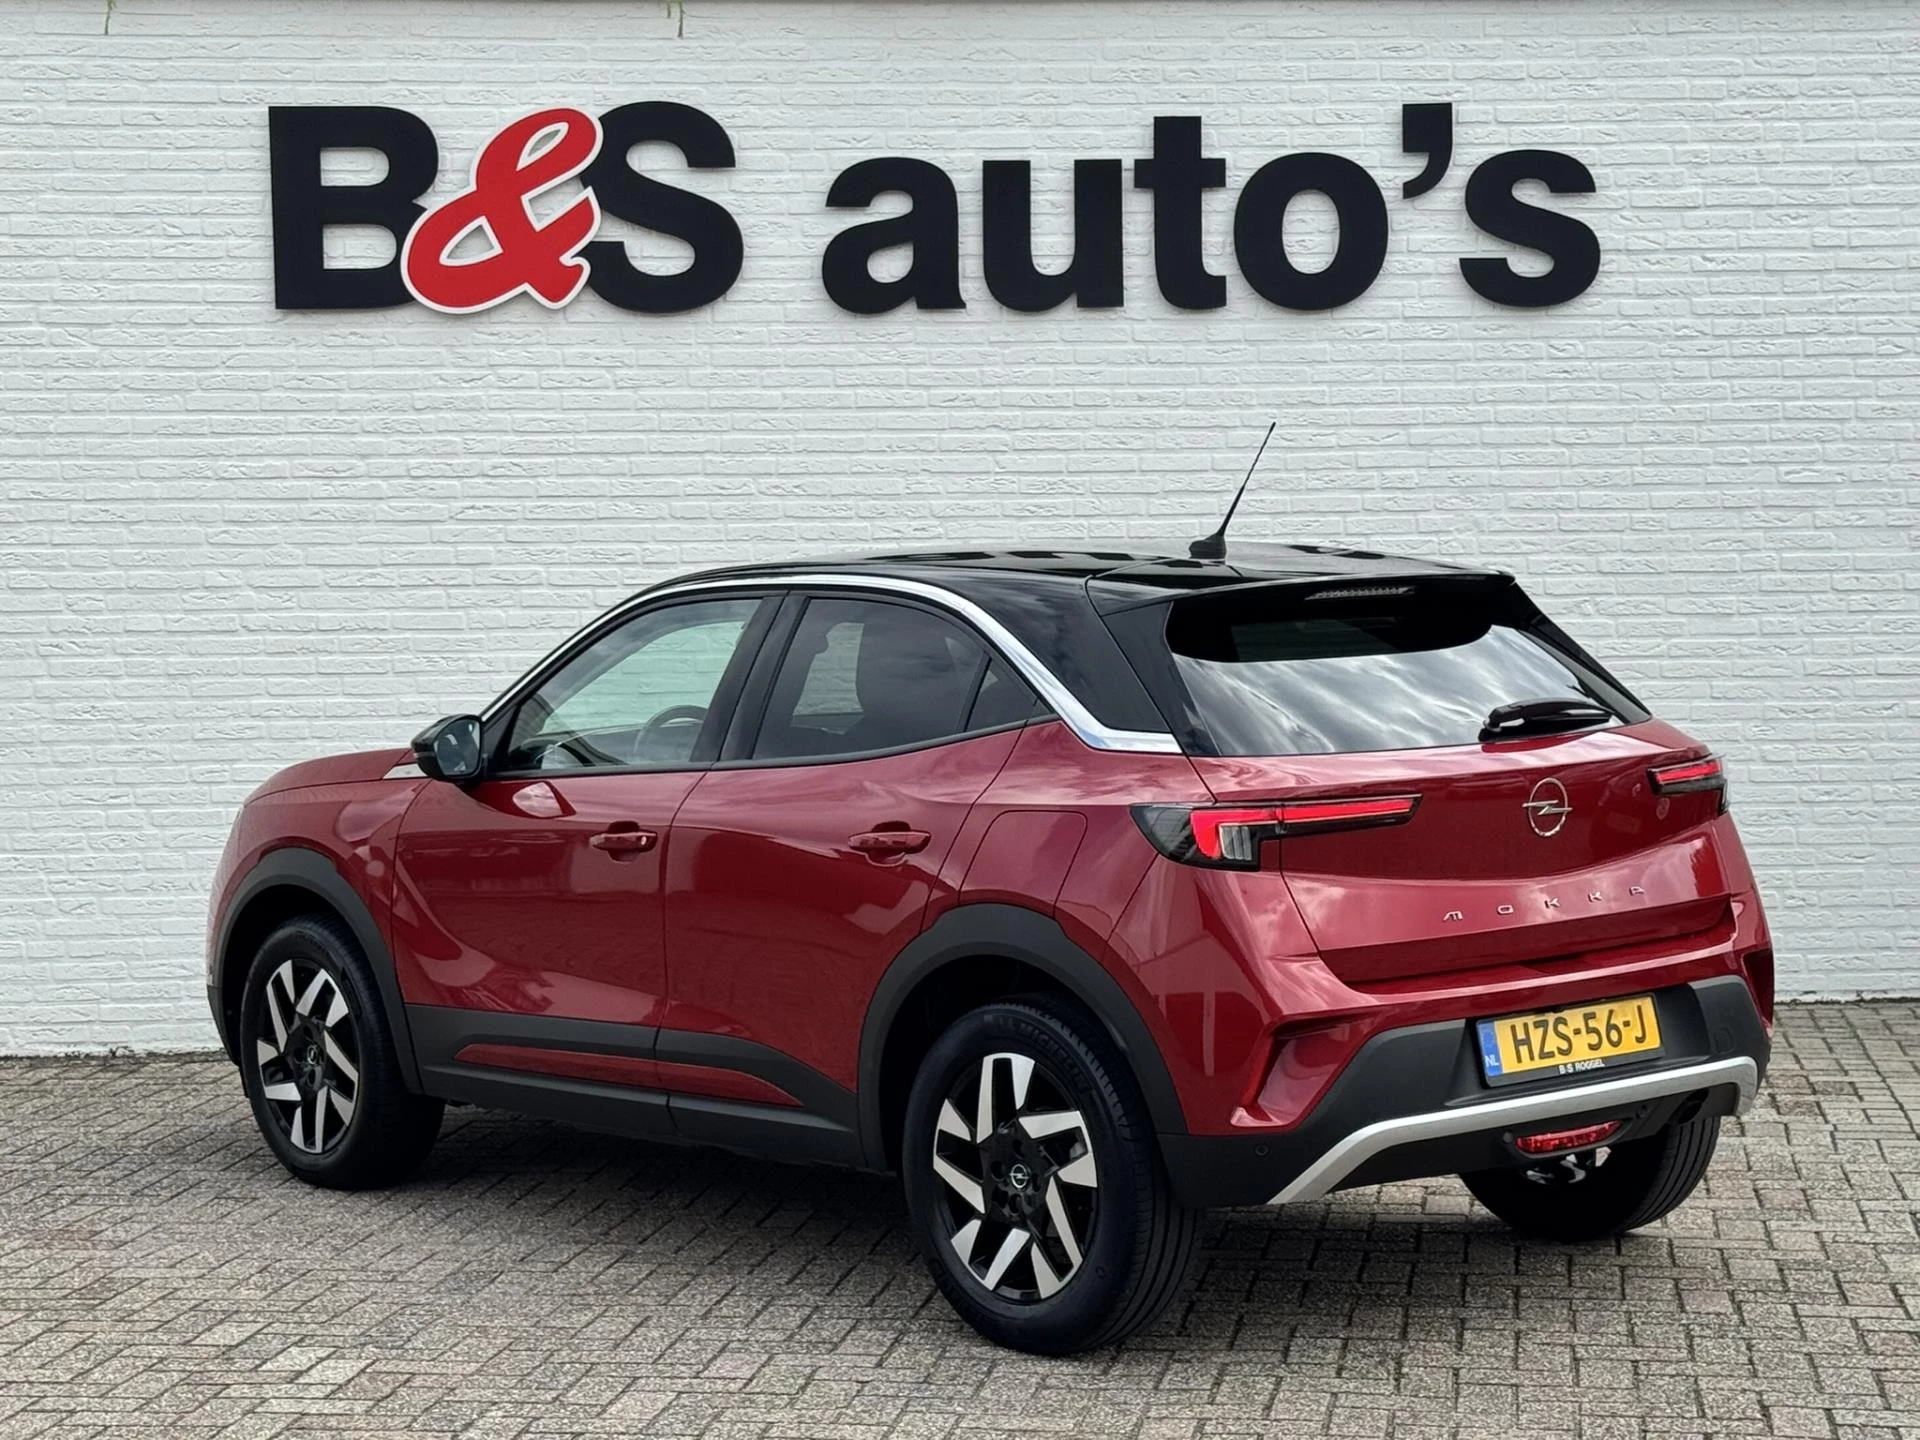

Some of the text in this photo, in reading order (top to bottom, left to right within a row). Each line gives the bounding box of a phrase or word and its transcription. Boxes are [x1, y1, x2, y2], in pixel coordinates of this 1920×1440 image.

[269, 101, 1601, 314] B&S auto's
[1443, 886, 1645, 921] MOKKA
[1510, 1004, 1647, 1064] HZS-56-J
[1484, 1054, 1500, 1068] NL
